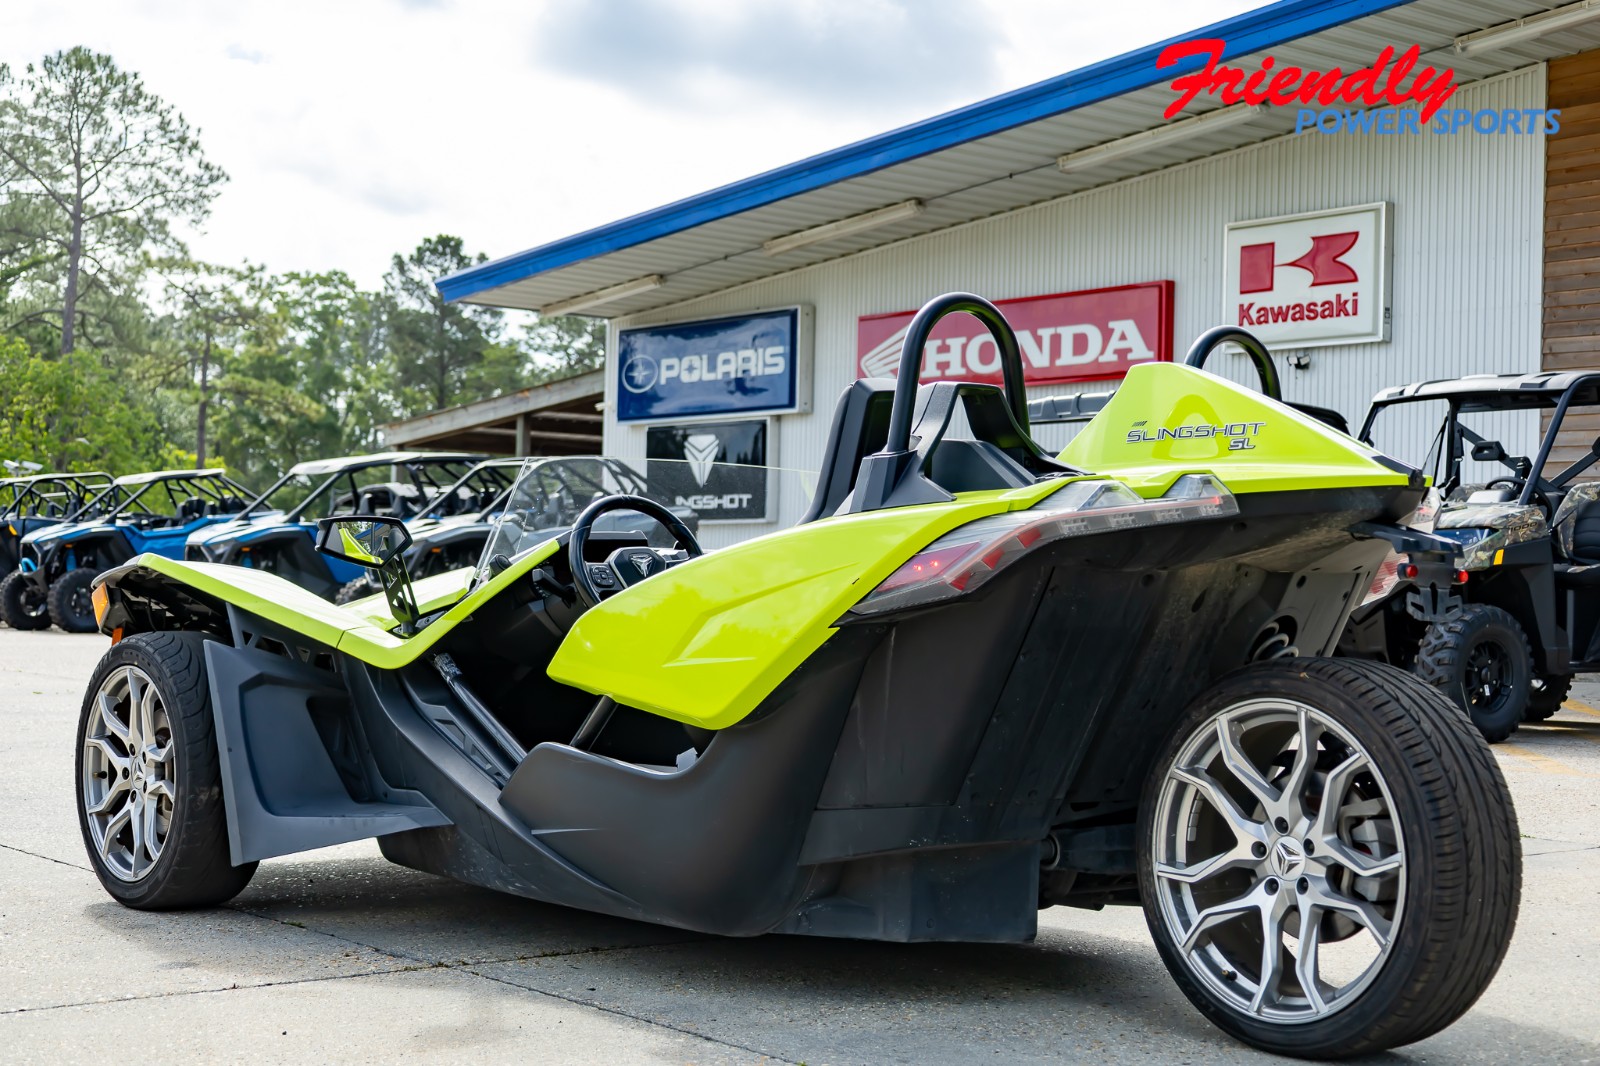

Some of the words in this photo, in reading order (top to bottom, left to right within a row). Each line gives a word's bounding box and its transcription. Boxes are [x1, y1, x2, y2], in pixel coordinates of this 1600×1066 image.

[1238, 292, 1359, 327] Kawasaki
[920, 318, 1155, 379] HONDA
[660, 346, 786, 386] POLARIS
[1126, 421, 1267, 444] SLINGSHOT
[1228, 437, 1257, 451] SL
[674, 493, 753, 510] INGSHOT
[1509, 521, 1538, 532] 1000
